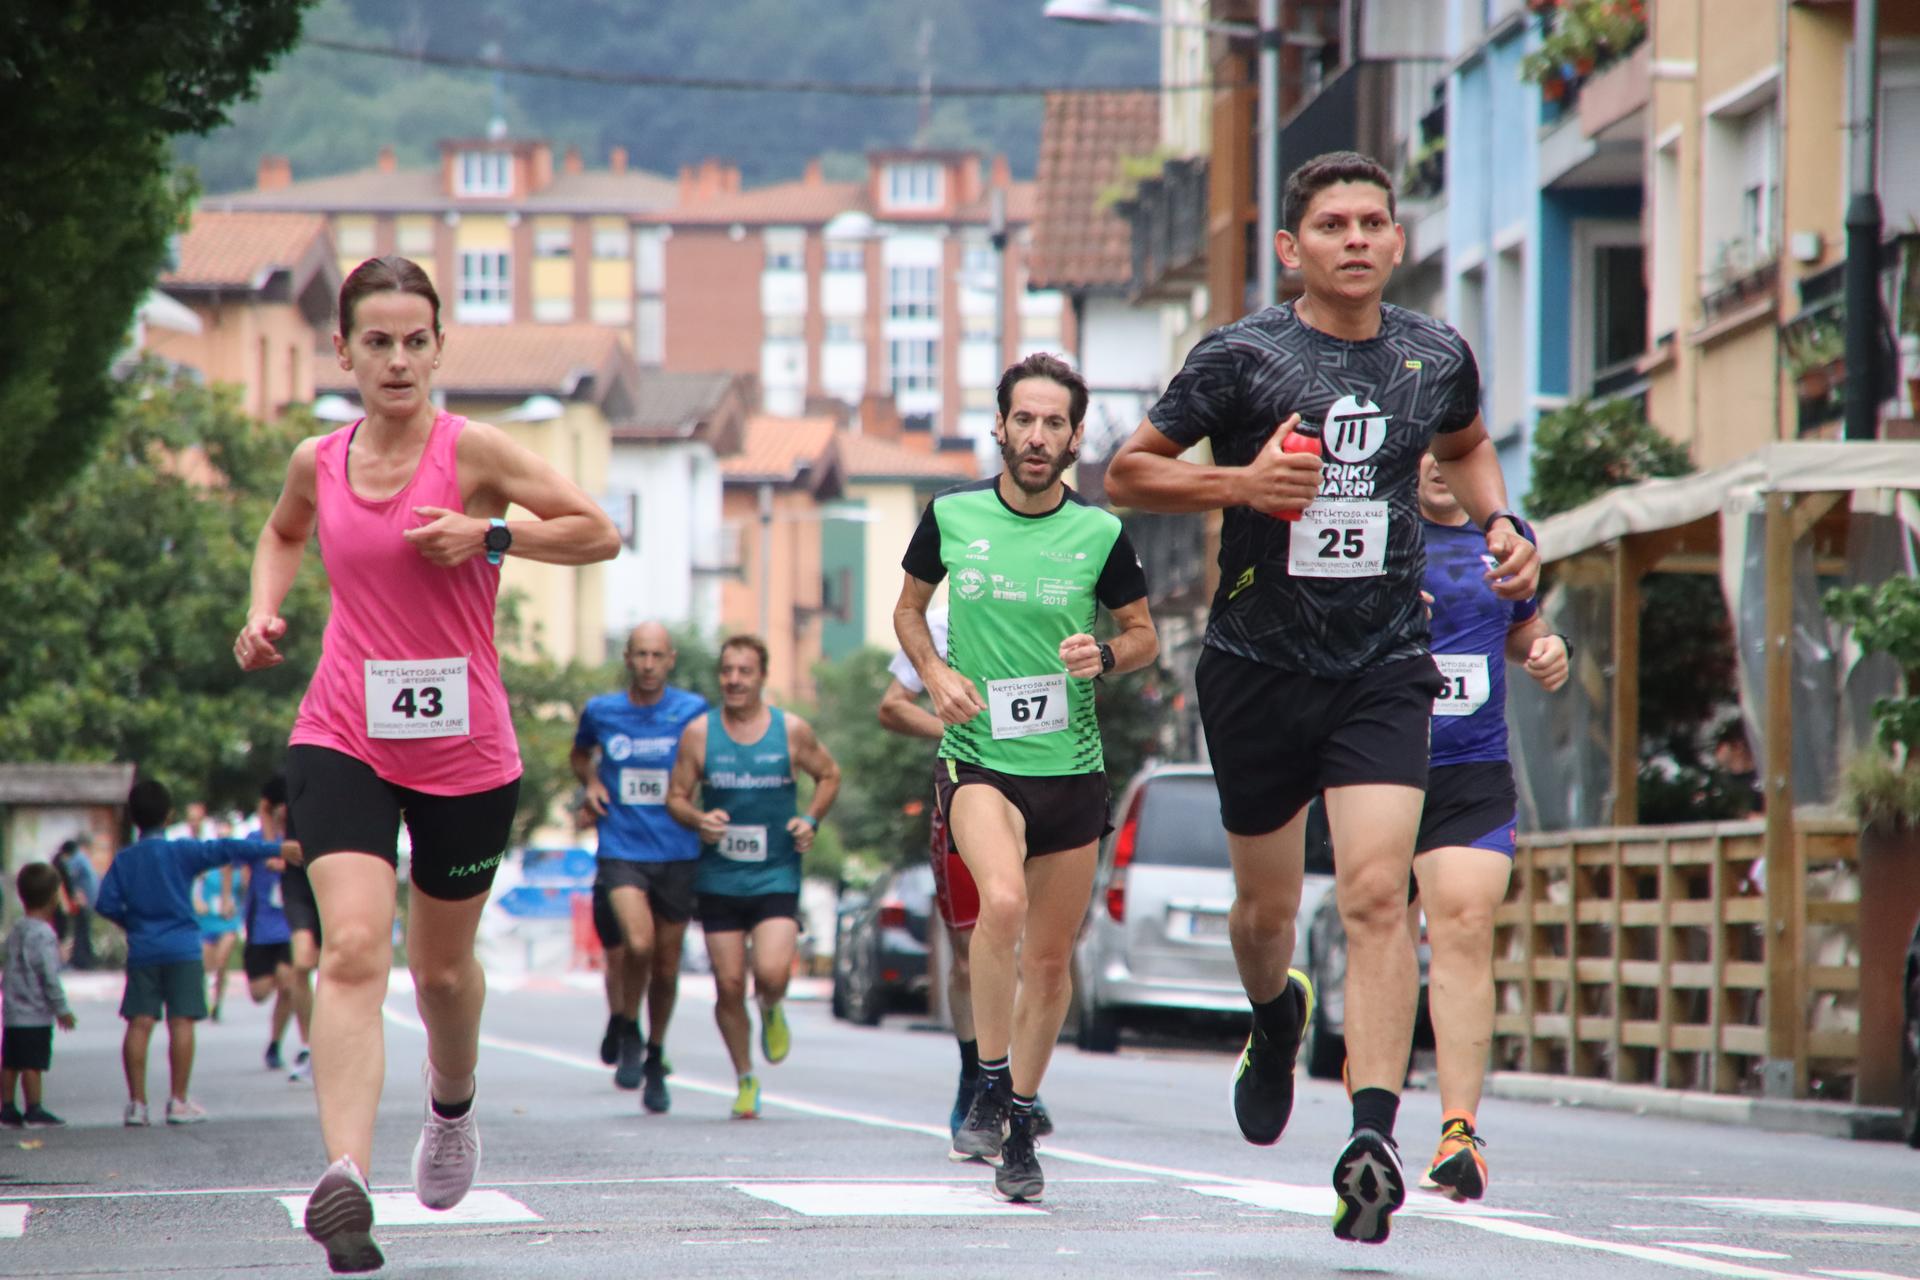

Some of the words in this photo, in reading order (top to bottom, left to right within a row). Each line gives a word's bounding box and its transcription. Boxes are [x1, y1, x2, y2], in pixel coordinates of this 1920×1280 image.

[1303, 508, 1384, 519] errikrosa.eus
[1318, 528, 1365, 559] 25
[392, 687, 444, 719] 43
[1011, 695, 1048, 722] 67
[629, 781, 661, 796] 106
[727, 839, 759, 853] 109
